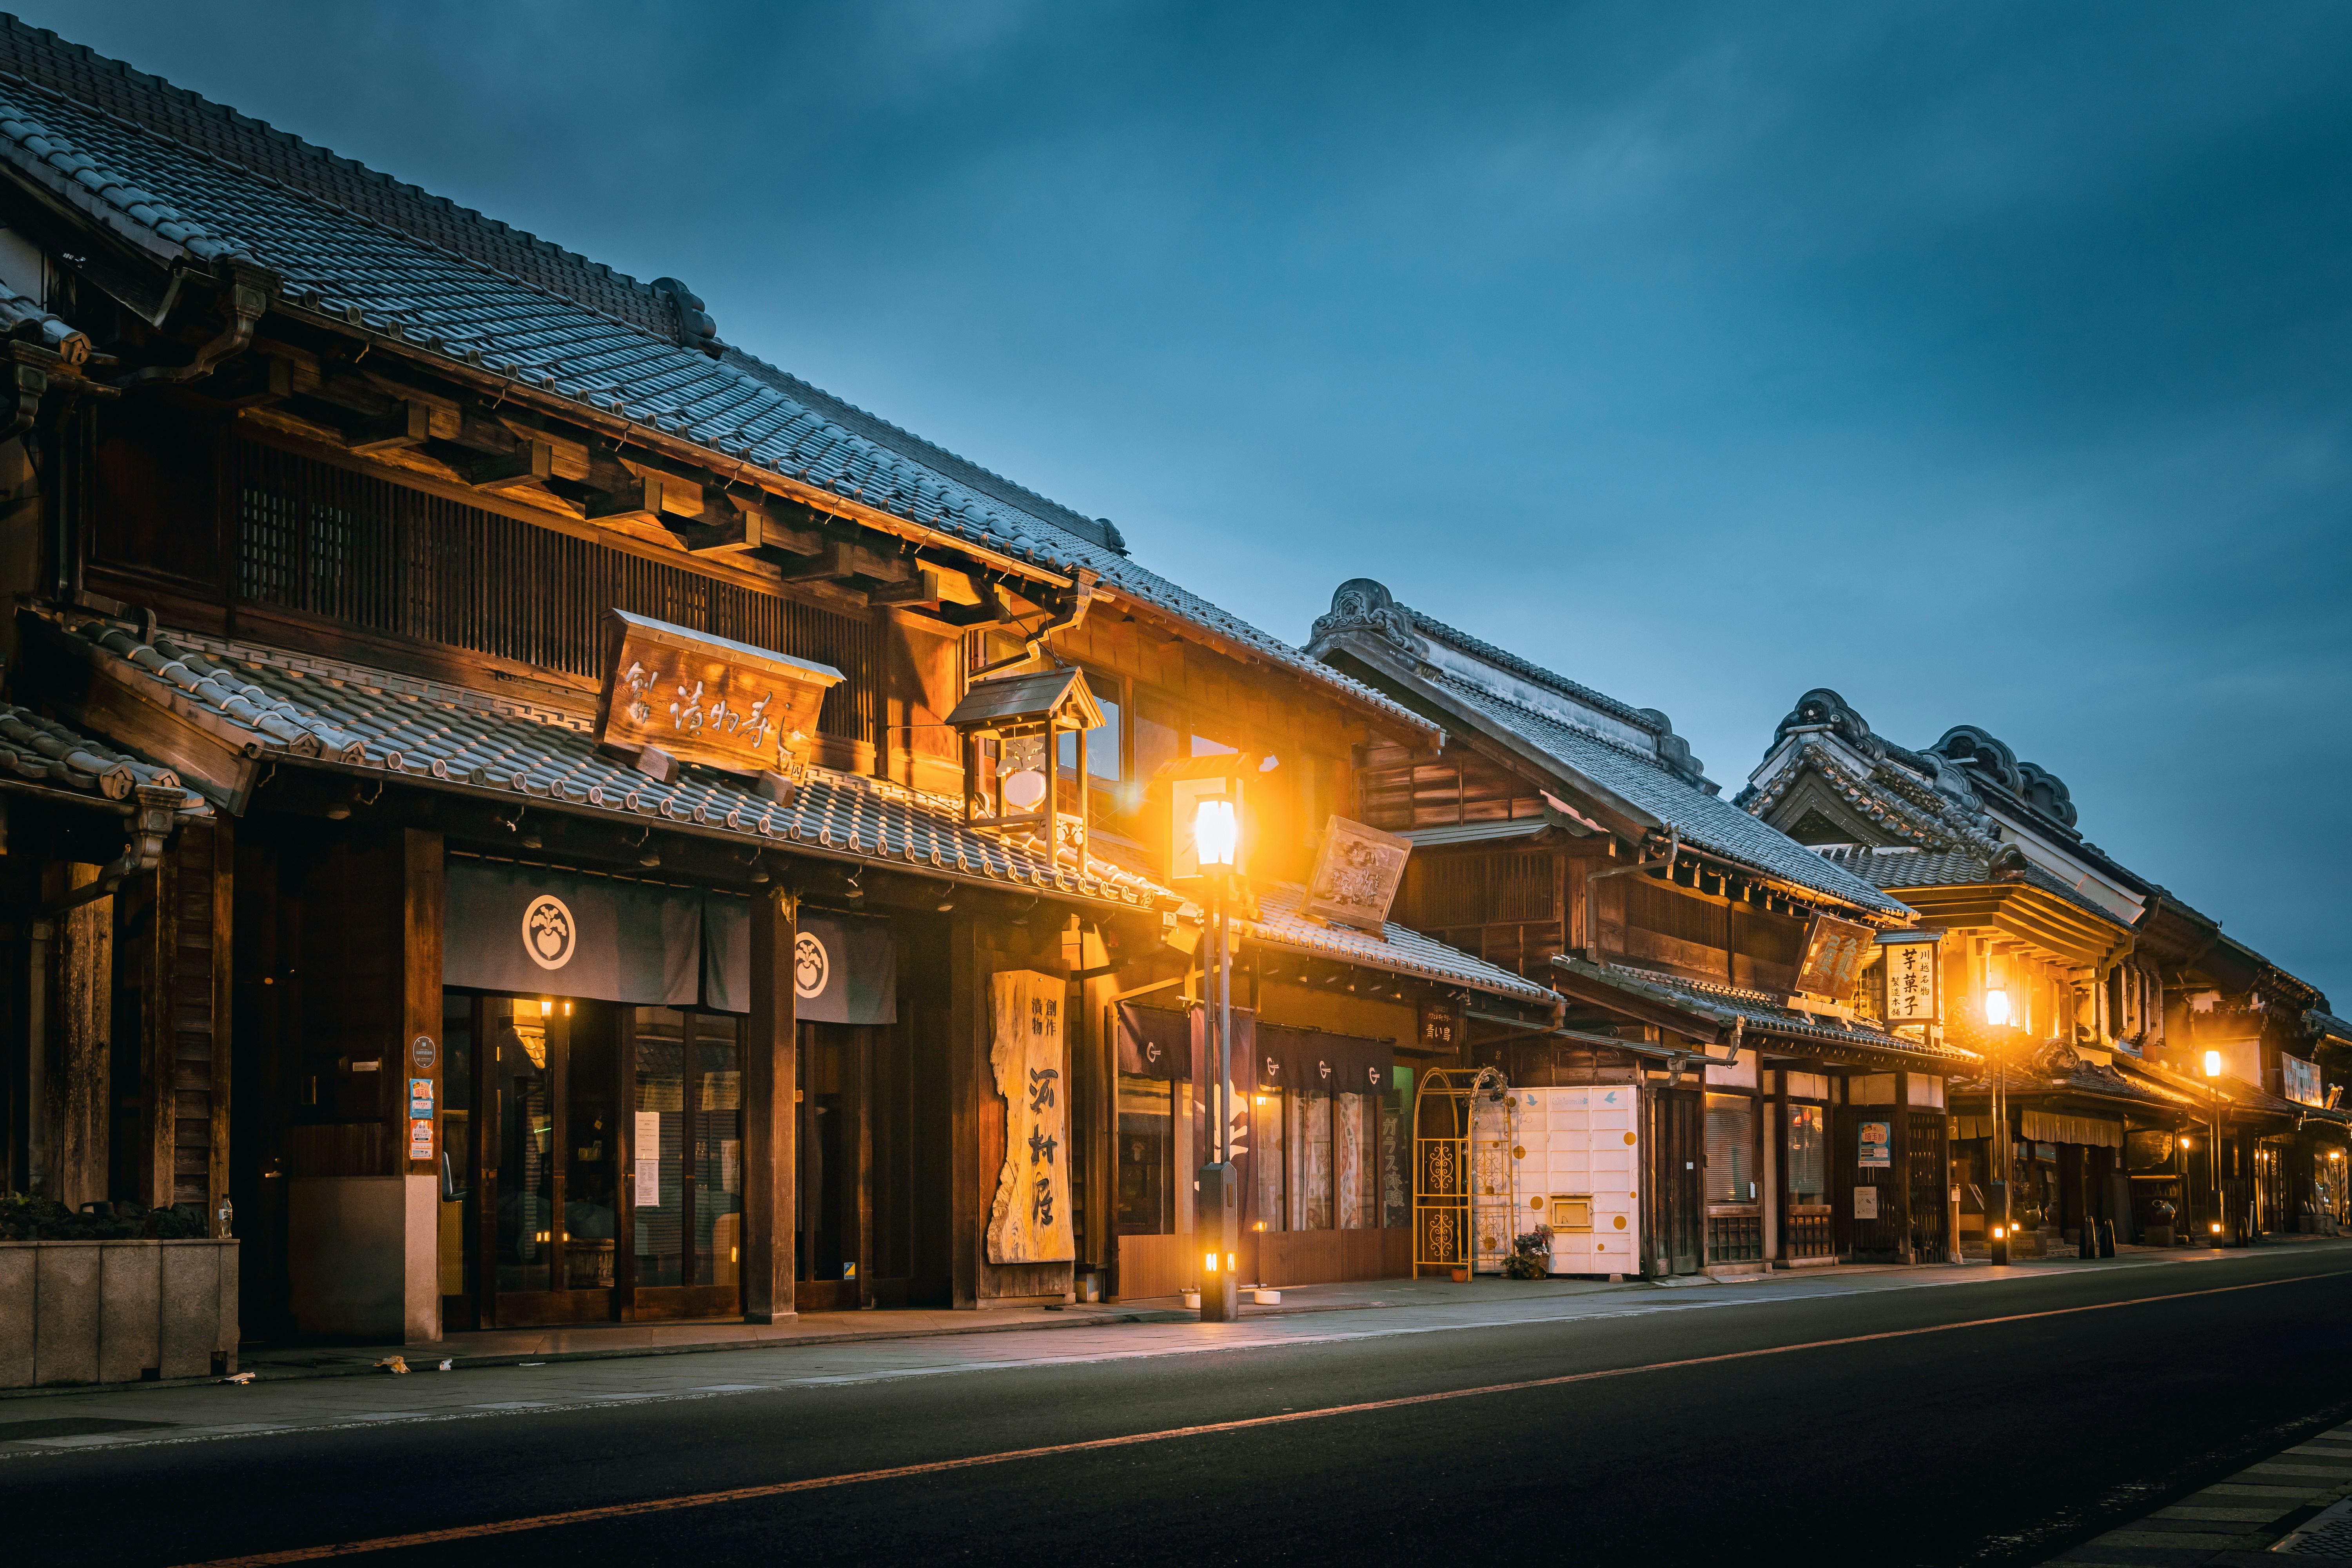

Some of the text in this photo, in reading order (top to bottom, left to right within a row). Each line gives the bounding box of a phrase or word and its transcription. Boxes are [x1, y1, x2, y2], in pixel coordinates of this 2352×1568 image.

[1902, 949, 1918, 1016] 芋菓子
[1920, 950, 1929, 996] 川越名物
[1891, 976, 1900, 1016] 製造本舗
[1032, 997, 1042, 1035] 漬物
[1046, 999, 1056, 1036] 創作
[1426, 1024, 1451, 1041] 青い鳥
[1865, 1132, 1884, 1141] 埼玉割
[1383, 1118, 1405, 1207] ガラス体験
